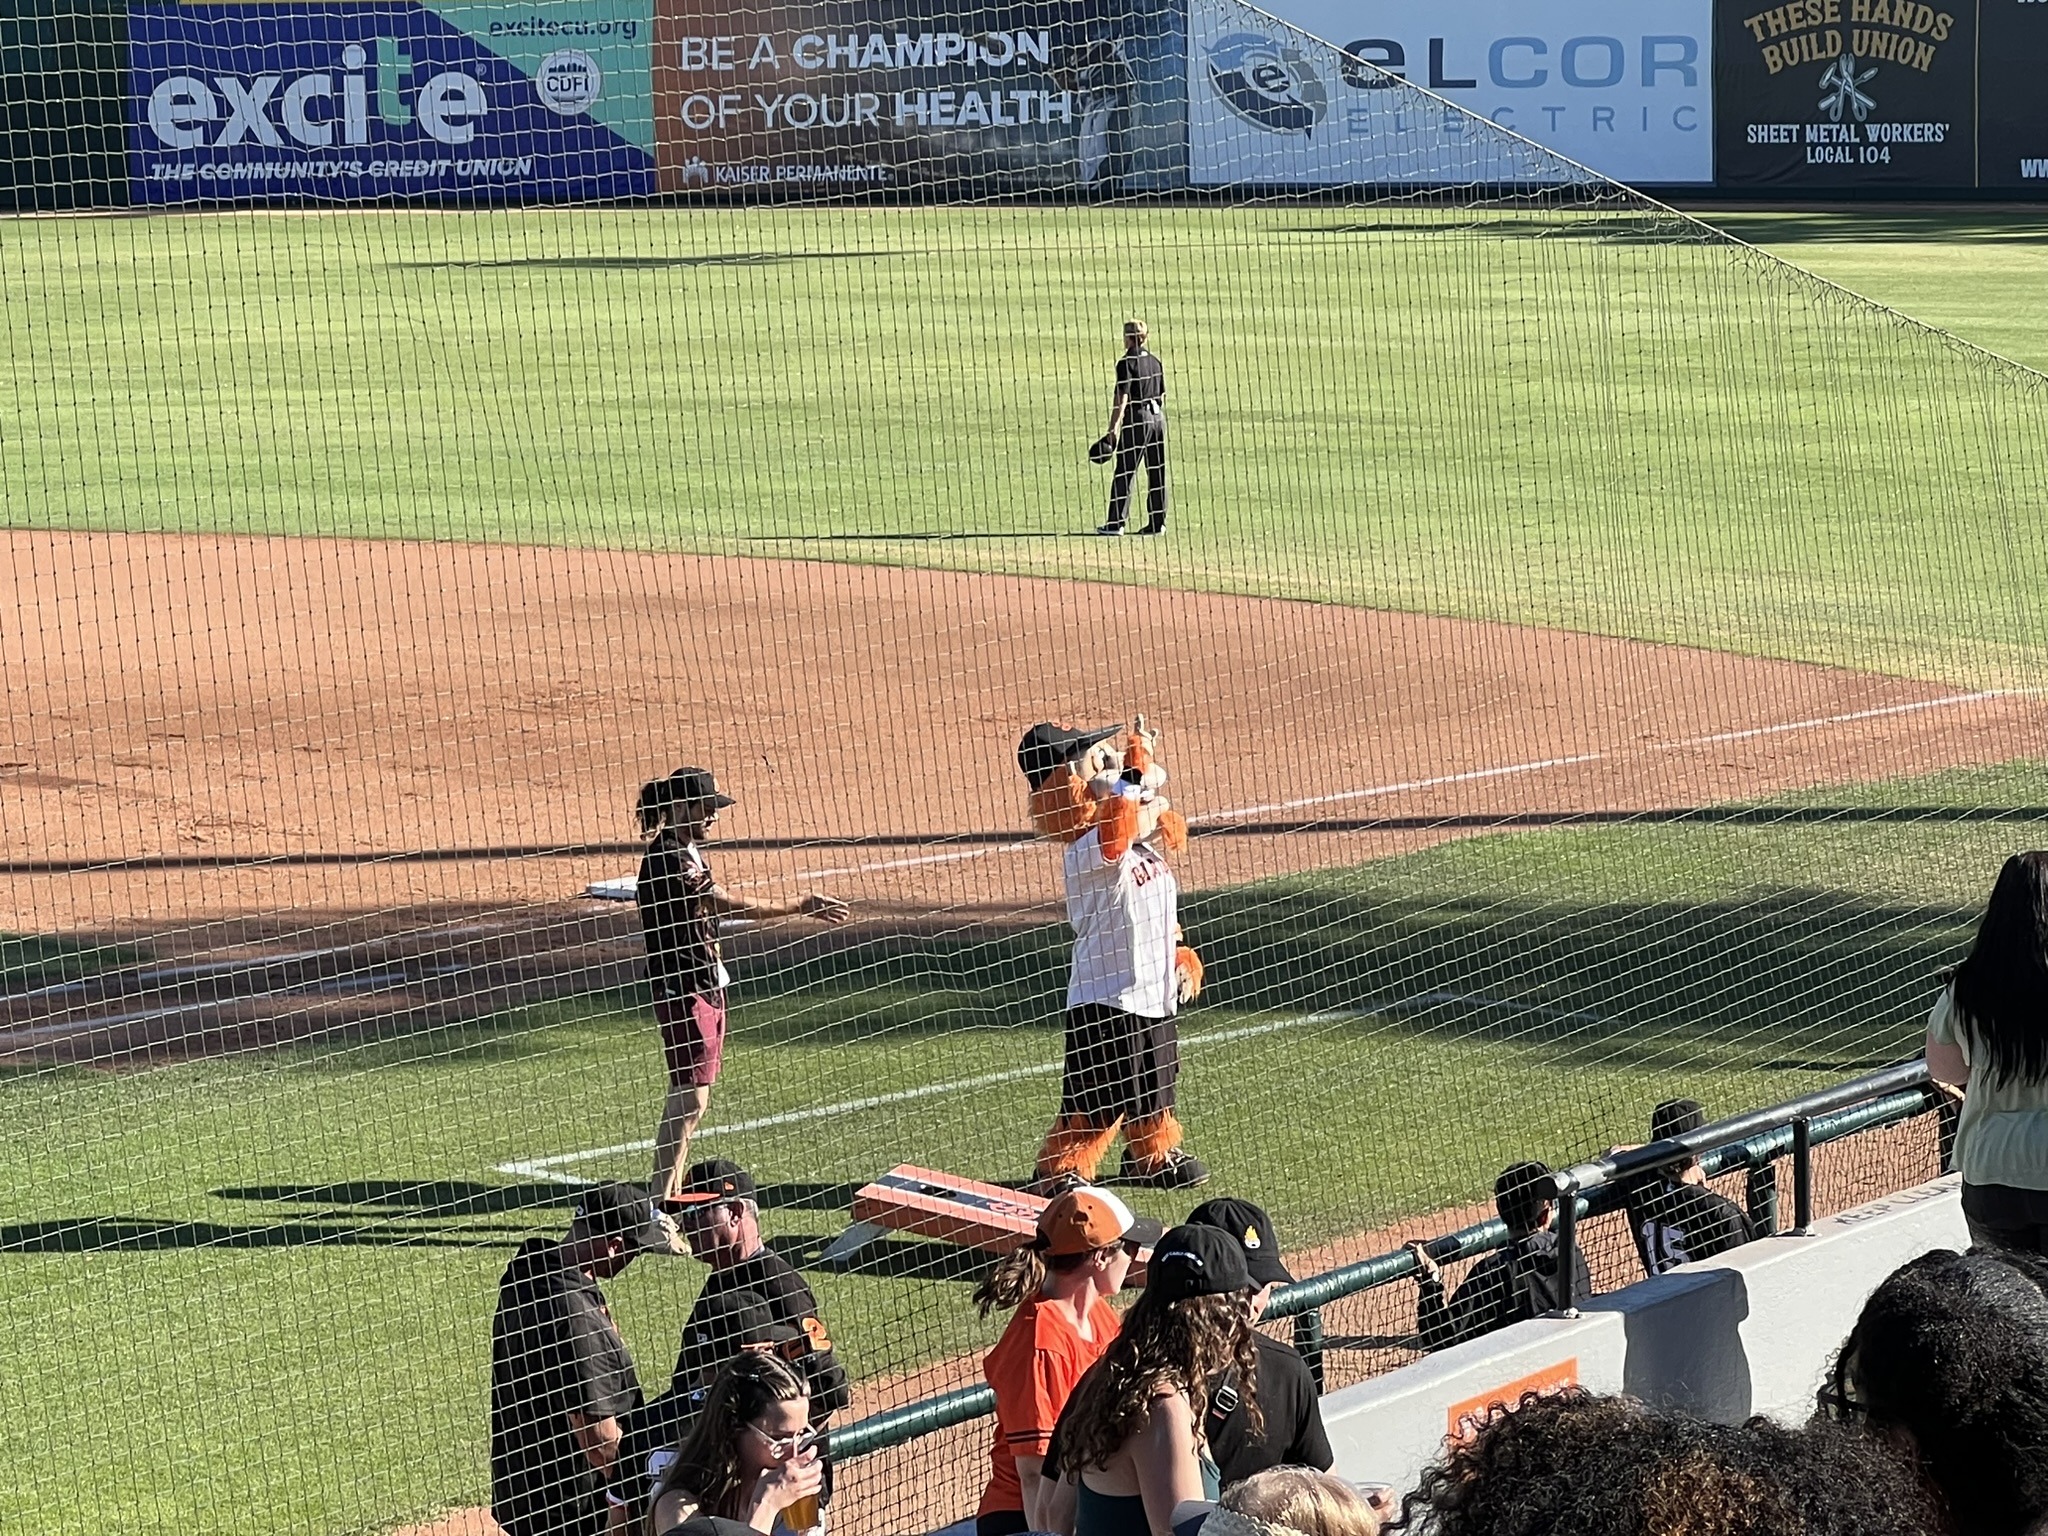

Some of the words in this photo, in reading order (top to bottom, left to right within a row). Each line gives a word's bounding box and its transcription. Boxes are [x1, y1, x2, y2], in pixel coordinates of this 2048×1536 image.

[489, 16, 637, 40] excitecu.org
[1744, 0, 1841, 43] THESE
[1850, 0, 1954, 41] HANDS
[681, 37, 735, 71] BE
[749, 36, 781, 70] A
[792, 31, 1049, 69] CHAMPION
[1761, 30, 1843, 75] BUILD
[1851, 29, 1936, 72] UNION
[147, 37, 489, 149] excite
[546, 76, 590, 92] CDFI
[681, 93, 741, 130] OF
[754, 93, 881, 128] YOUR
[894, 90, 1072, 126] HEALTH
[1347, 106, 1699, 134] ELECTRIC
[1747, 124, 1800, 143] SHEET
[1805, 124, 1860, 143] METAL
[1865, 123, 1950, 143] WORKERS'
[1806, 146, 1854, 163] LOCAL
[1859, 146, 1891, 163] 104
[150, 163, 195, 181] THE
[368, 159, 451, 178] CREDIT
[456, 158, 532, 177] UNION
[716, 166, 770, 183] KAISER
